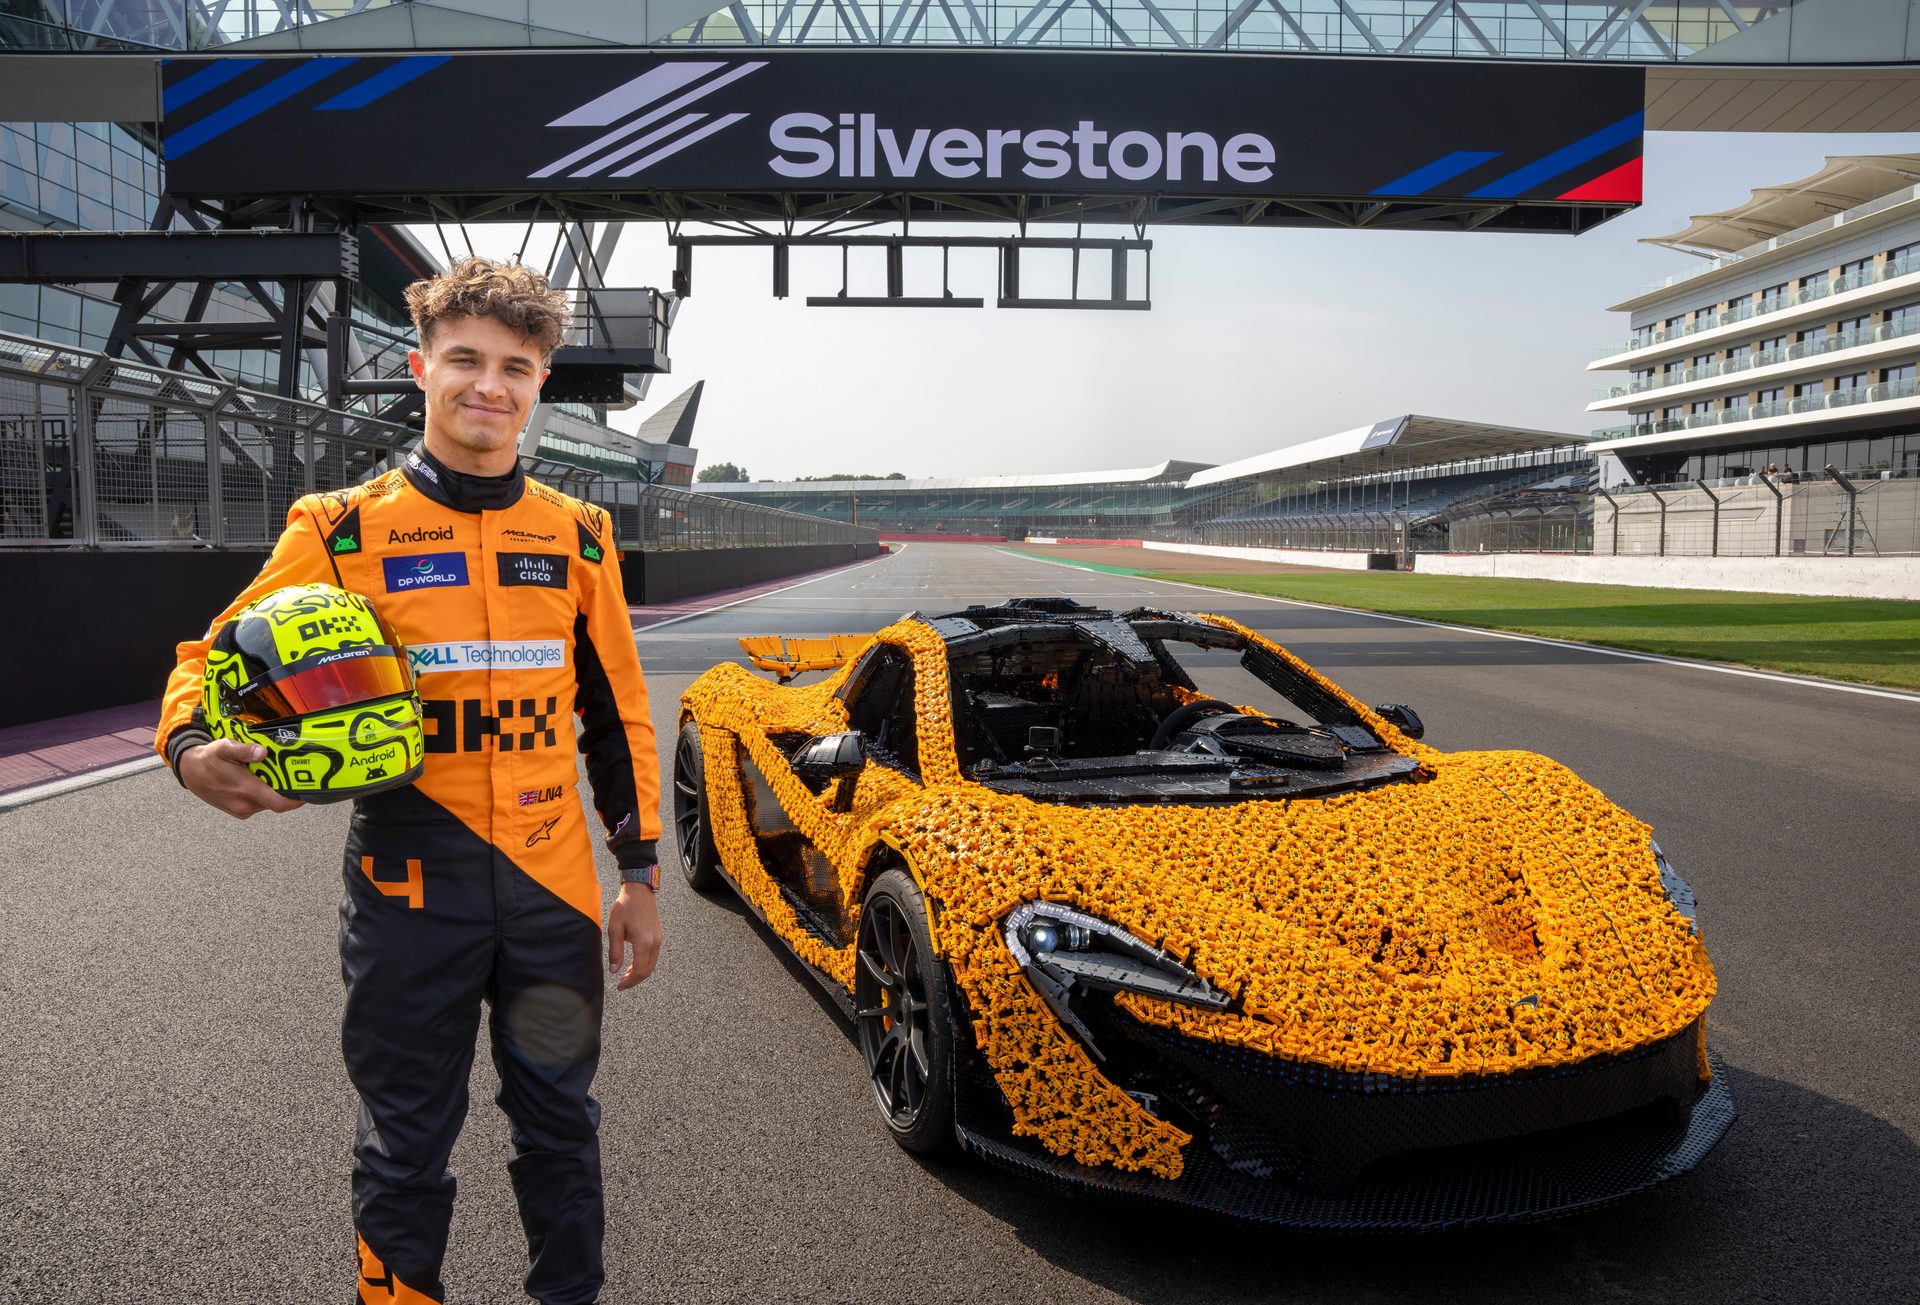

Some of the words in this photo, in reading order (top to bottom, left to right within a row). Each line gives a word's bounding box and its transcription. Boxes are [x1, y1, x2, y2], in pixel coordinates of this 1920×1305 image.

[768, 112, 1276, 183] Silverstone
[366, 478, 401, 492] Hilton
[388, 525, 454, 545] Android
[501, 529, 554, 543] McLaren
[398, 577, 414, 587] DP
[414, 573, 457, 585] WORLD
[519, 571, 551, 582] CISCO
[317, 649, 370, 666] McLaren
[461, 645, 561, 666] Technologies
[350, 747, 395, 767] Android
[538, 785, 563, 803] LN4
[361, 855, 424, 909] 4
